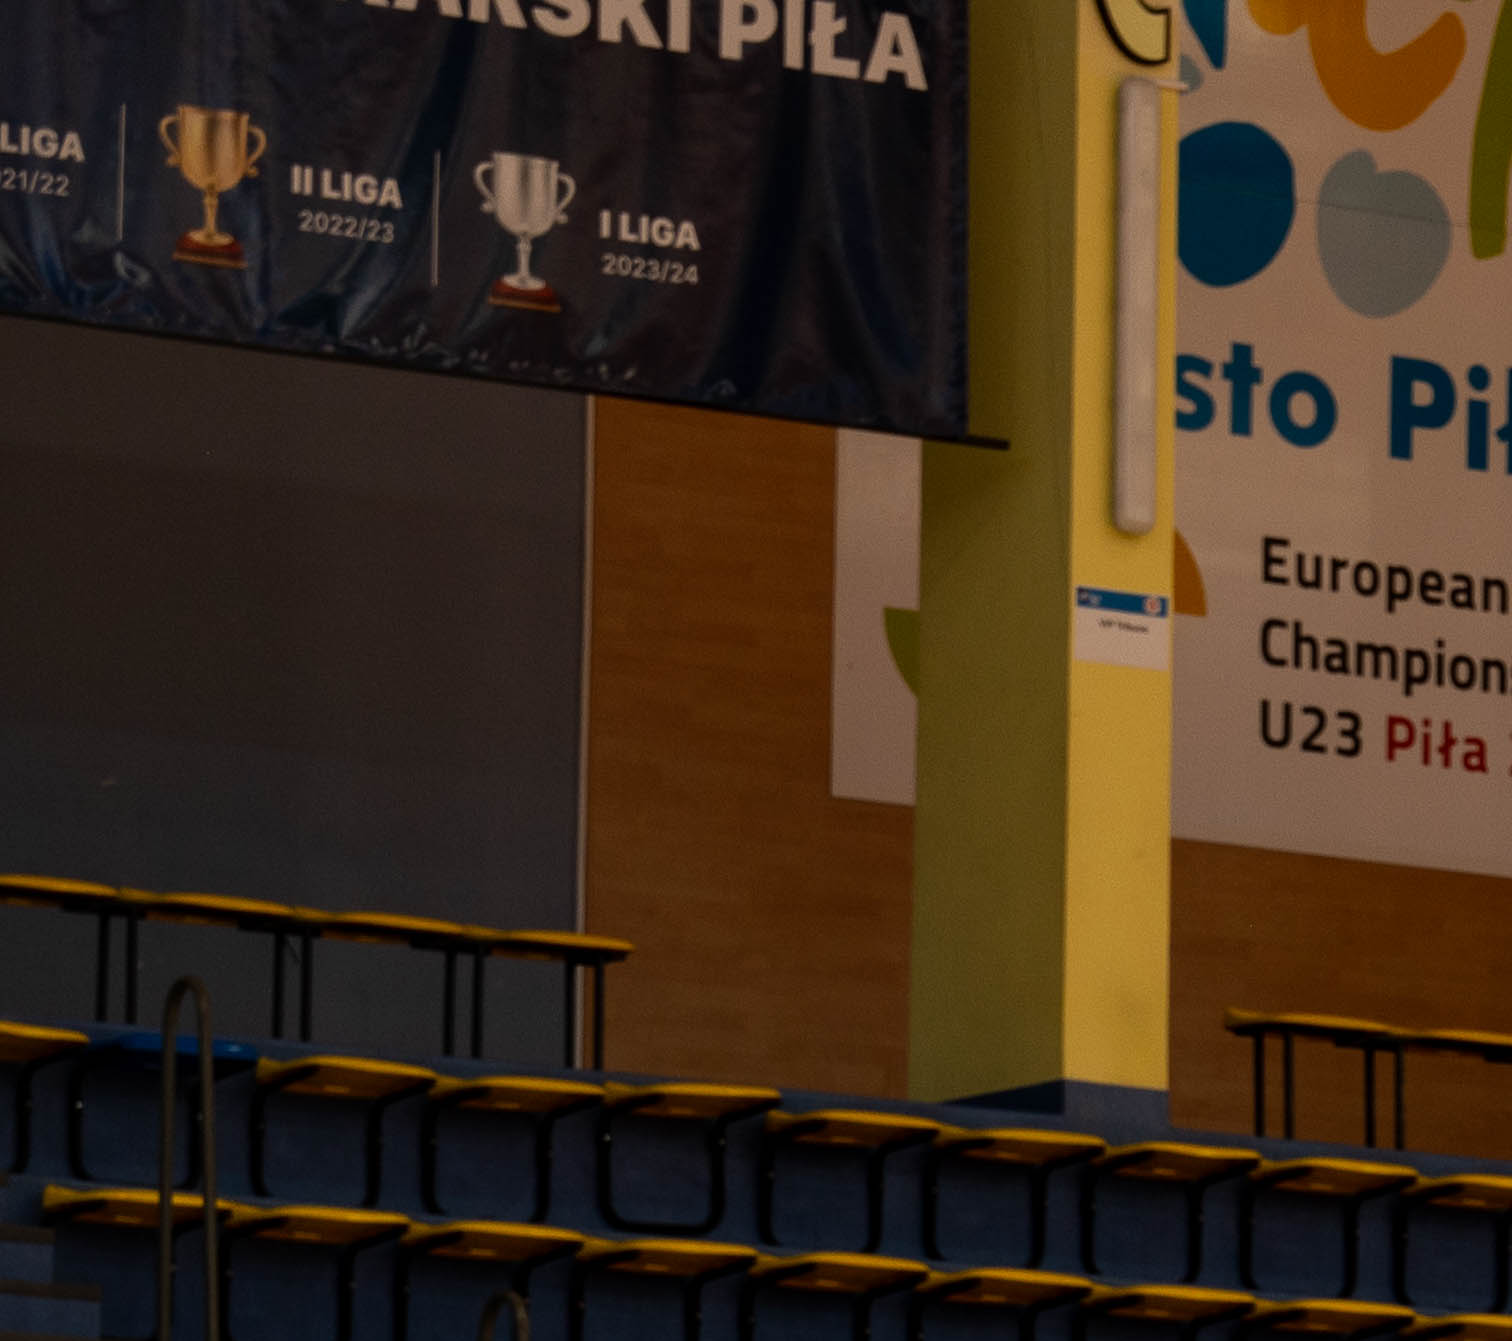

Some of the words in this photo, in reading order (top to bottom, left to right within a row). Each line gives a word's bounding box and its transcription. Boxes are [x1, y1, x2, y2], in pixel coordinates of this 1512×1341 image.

[716, 0, 929, 91] PIŁA
[290, 164, 313, 196] II
[320, 168, 403, 209] LIGA
[298, 209, 395, 243] 2022/23
[600, 208, 613, 240] I
[618, 212, 701, 251] LIGA
[602, 253, 699, 285] 2023/24
[1261, 536, 1510, 617] European
[1258, 700, 1364, 759] U23
[1386, 716, 1489, 775] Piła
